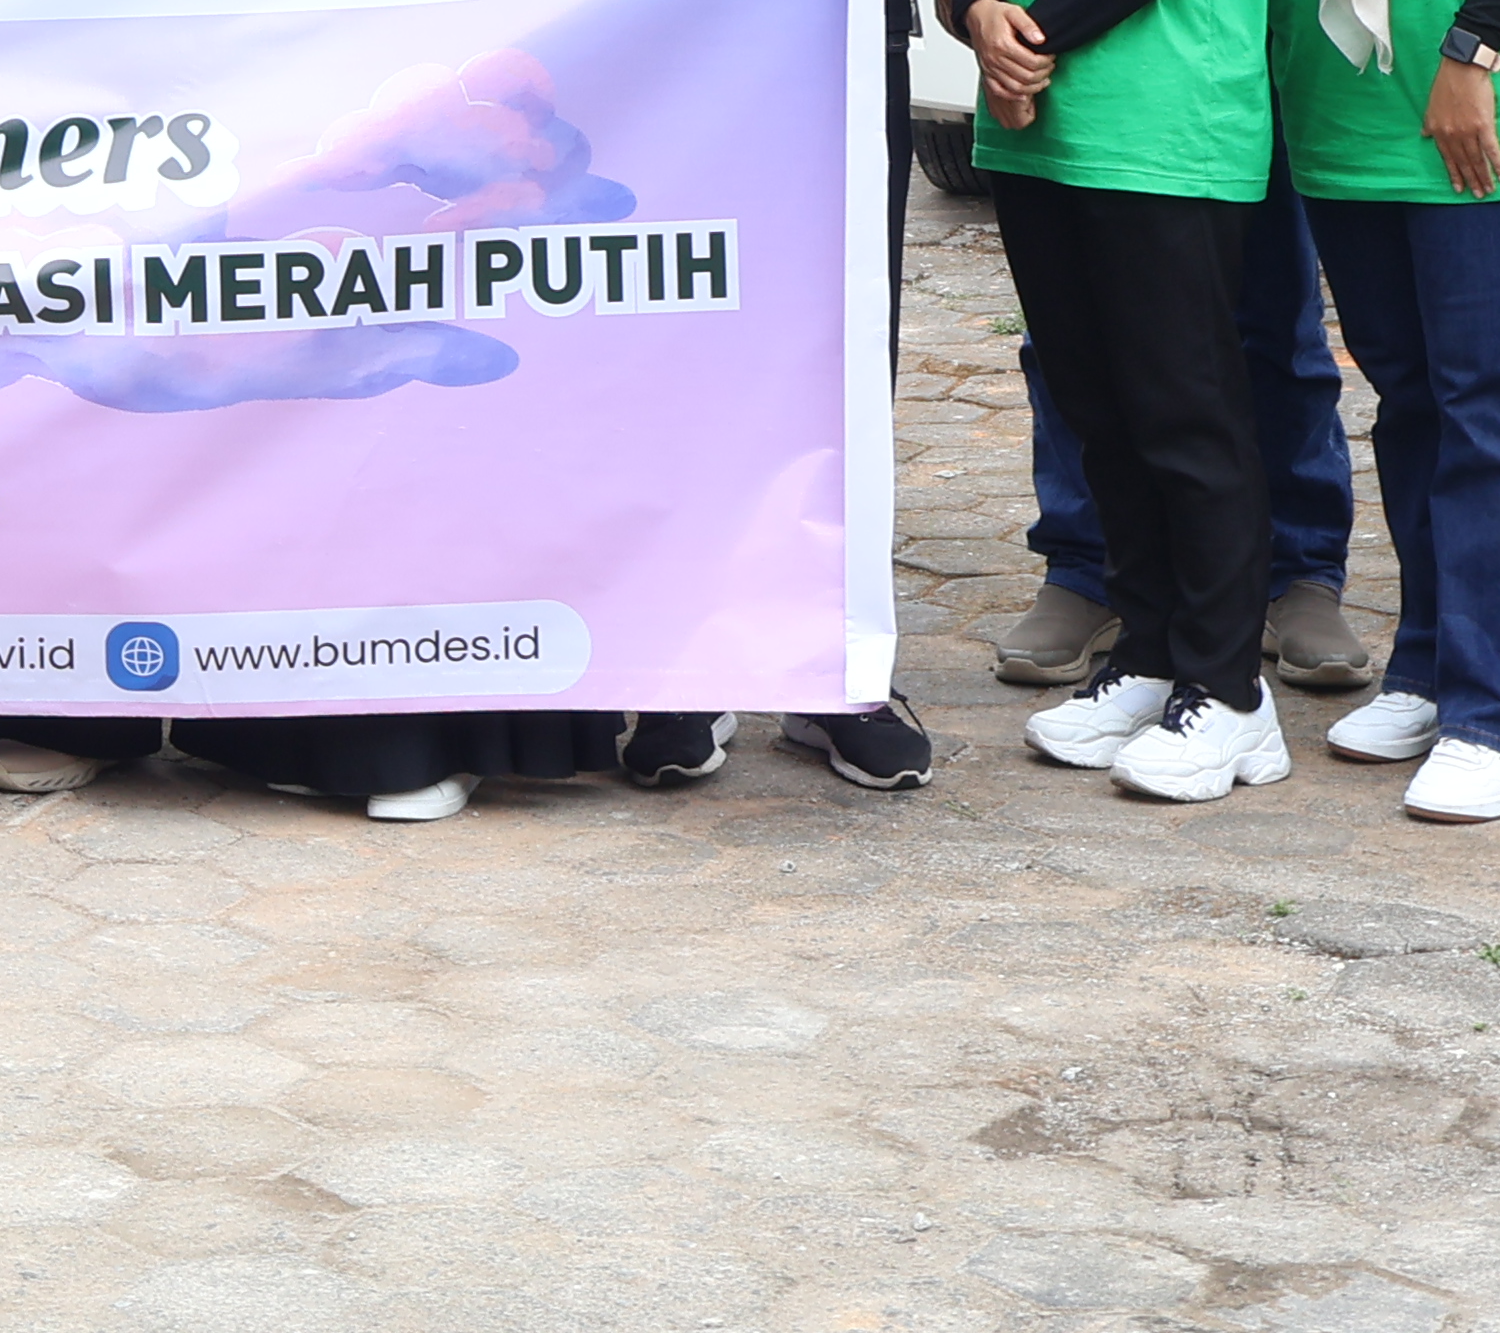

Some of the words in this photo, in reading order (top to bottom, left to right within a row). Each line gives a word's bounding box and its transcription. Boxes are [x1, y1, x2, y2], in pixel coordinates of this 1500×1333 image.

[144, 242, 445, 326] MERAH
[473, 230, 730, 307] PUTIH
[194, 626, 541, 675] www.bumdes.id
